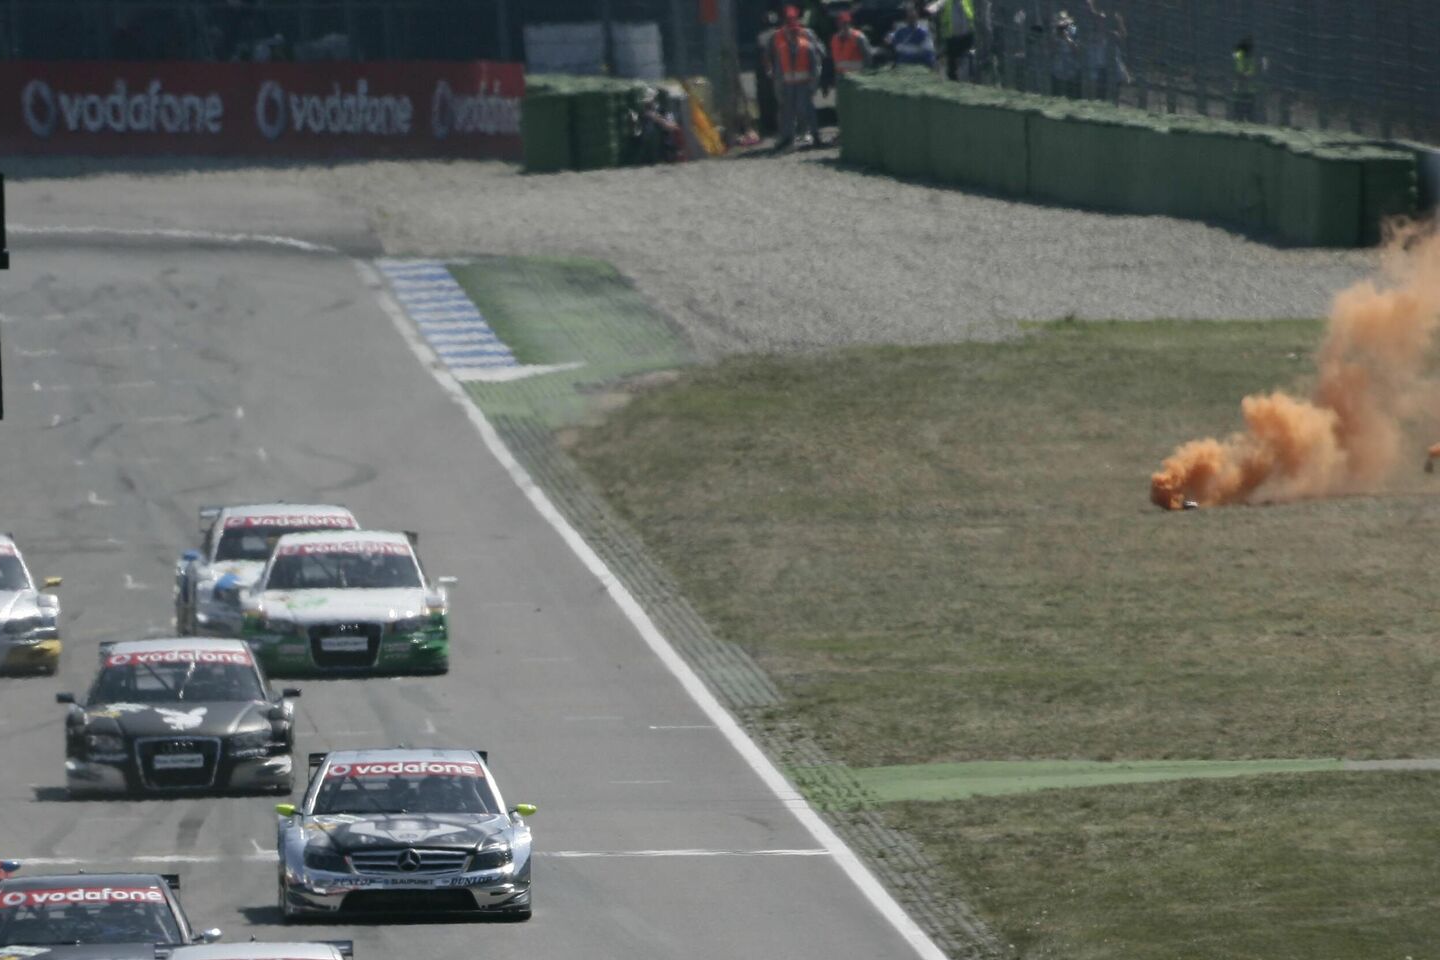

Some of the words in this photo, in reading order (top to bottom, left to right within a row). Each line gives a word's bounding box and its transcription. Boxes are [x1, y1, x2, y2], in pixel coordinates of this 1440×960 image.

[61, 78, 223, 133] vodafone
[290, 78, 414, 134] vodafone
[250, 515, 349, 527] vodafone
[136, 652, 249, 664] vodafone
[357, 763, 476, 775] vodafone
[32, 889, 162, 903] vodafone
